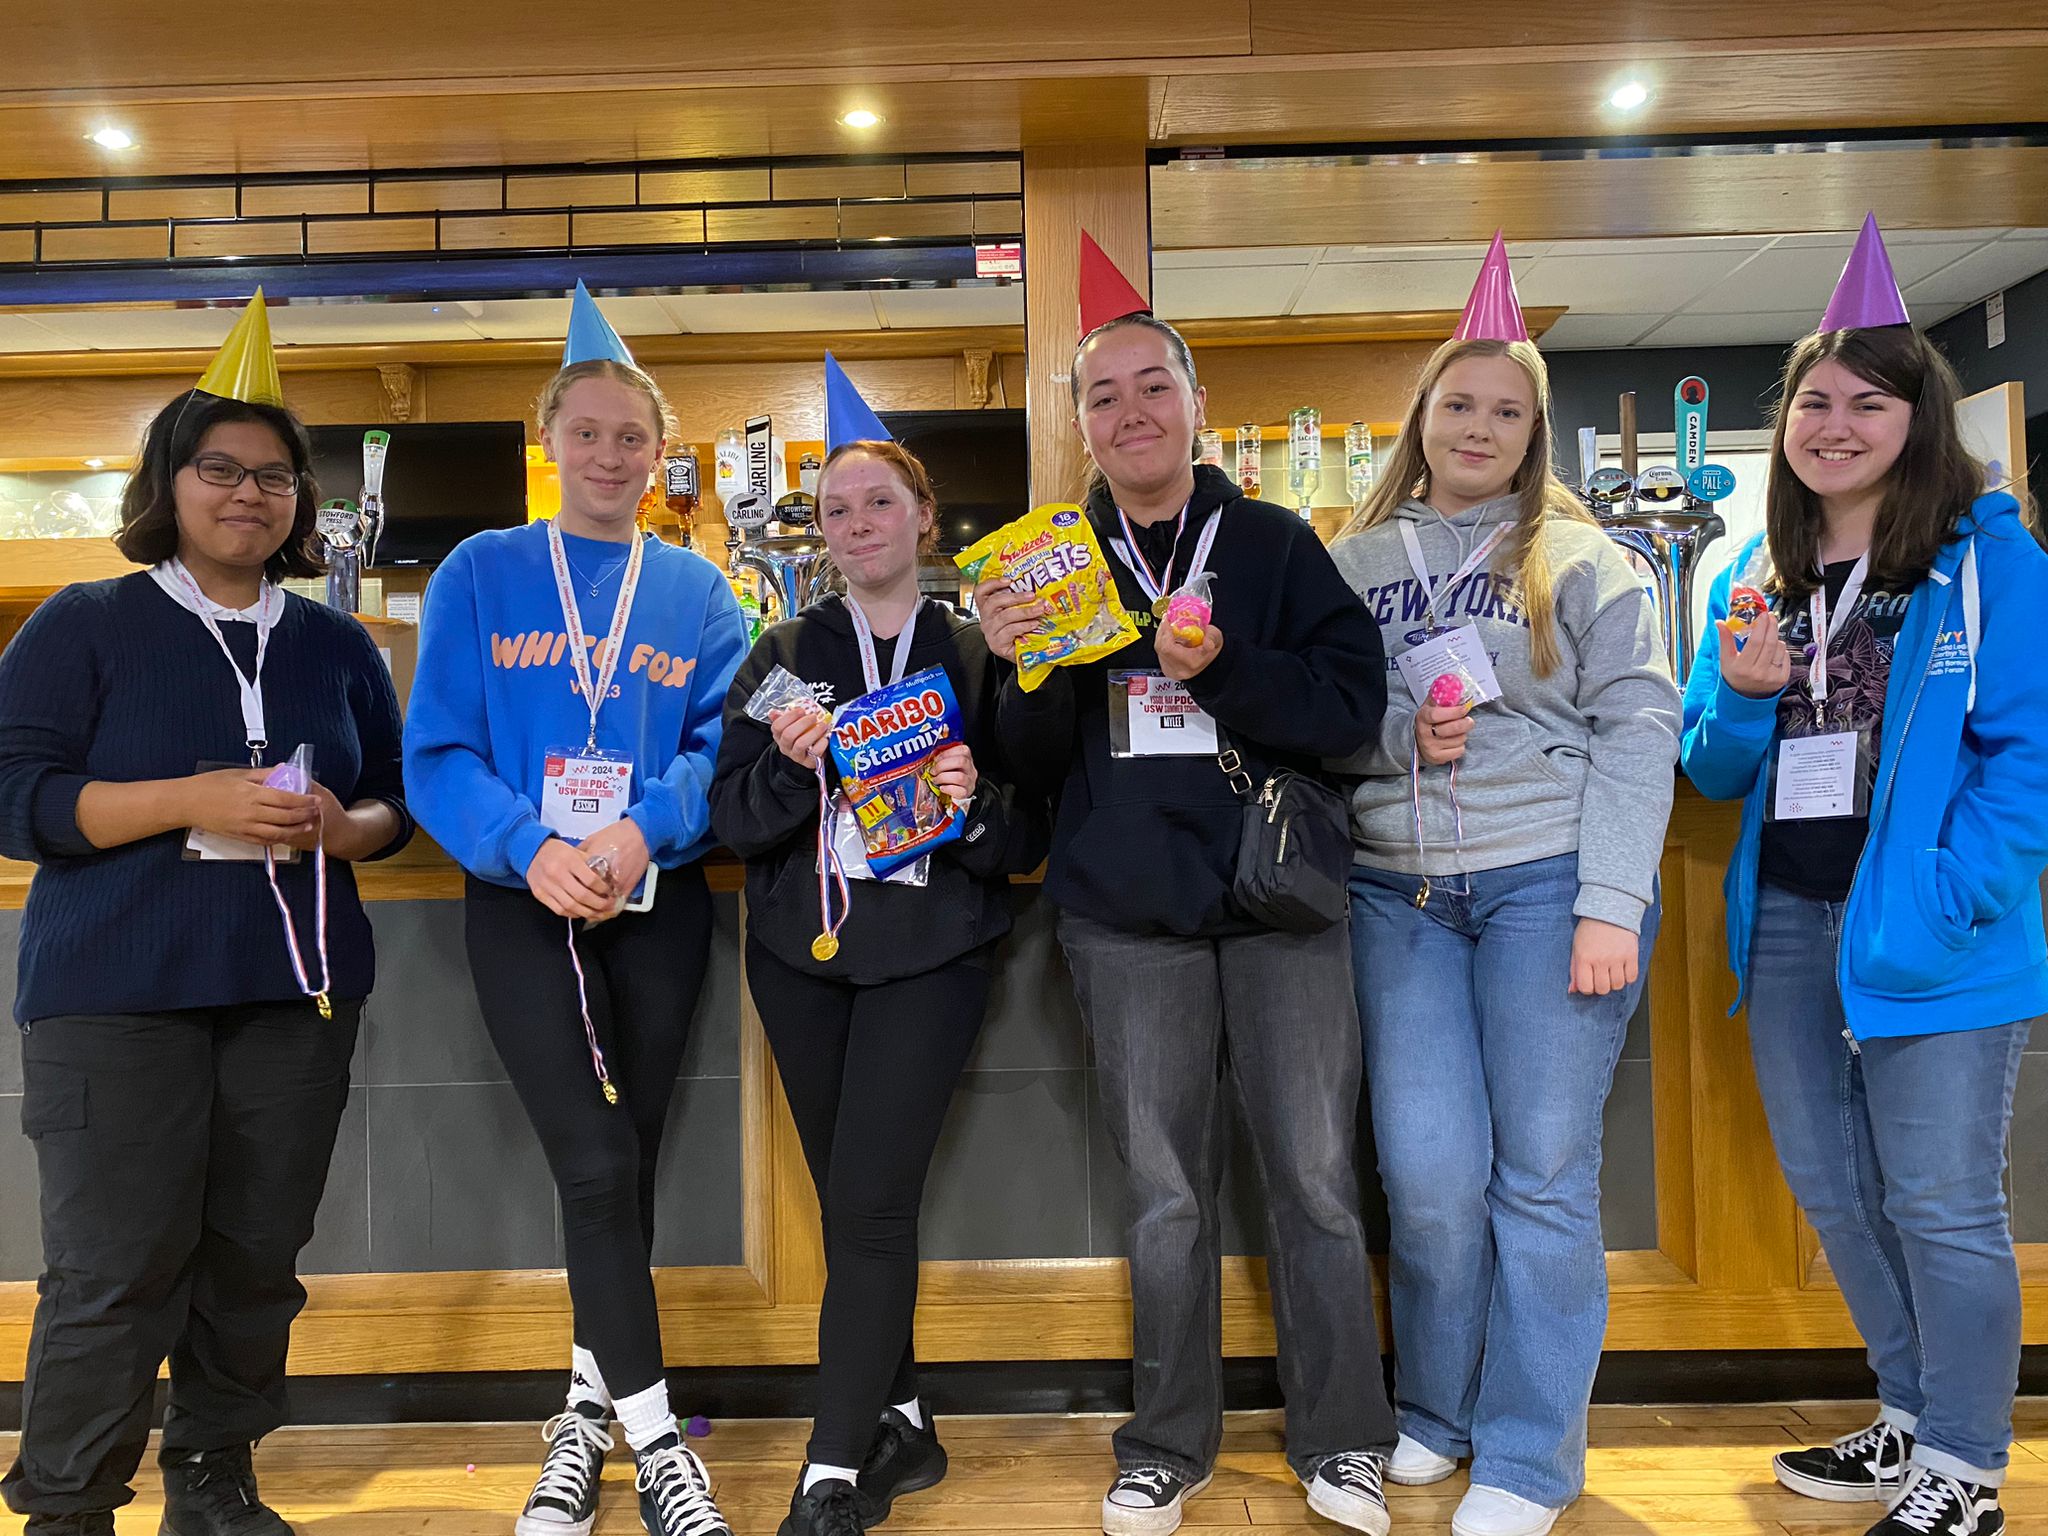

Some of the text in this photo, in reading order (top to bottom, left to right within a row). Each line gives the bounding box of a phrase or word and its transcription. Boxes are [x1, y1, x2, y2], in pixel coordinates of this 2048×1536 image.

[1689, 416, 1698, 464] CAMDEN
[751, 442, 767, 496] CARLING
[1702, 476, 1721, 490] PALE
[319, 510, 354, 520] STOWFORD
[732, 508, 764, 519] CARLING
[1059, 513, 1071, 522] 18
[1009, 541, 1092, 593] WEETS
[629, 644, 697, 688] FOX
[1174, 696, 1194, 705] PDC
[1144, 705, 1163, 713] USW
[836, 690, 944, 749] HARIBO
[1163, 716, 1182, 728] MYLEE
[855, 725, 944, 772] Starmix
[592, 766, 613, 775] 2024
[590, 779, 609, 789] PDC
[558, 786, 578, 796] USW
[863, 801, 880, 817] 11
